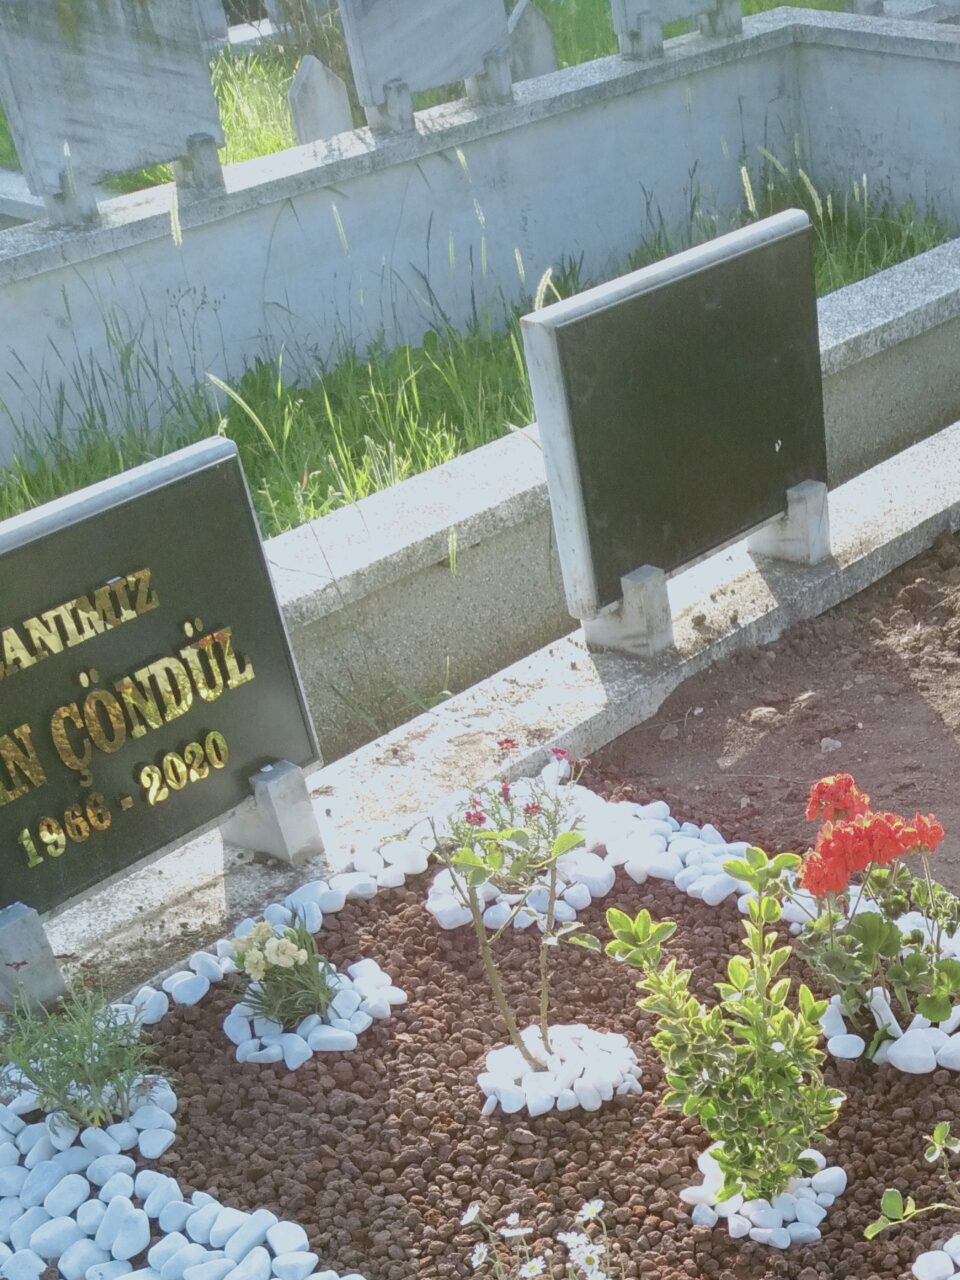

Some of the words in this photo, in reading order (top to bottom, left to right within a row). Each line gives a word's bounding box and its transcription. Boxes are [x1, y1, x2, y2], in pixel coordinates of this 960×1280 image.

[0, 568, 160, 680] ANIMIZ
[51, 616, 256, 787] ÇÖNDÜL
[140, 730, 229, 807] 2020
